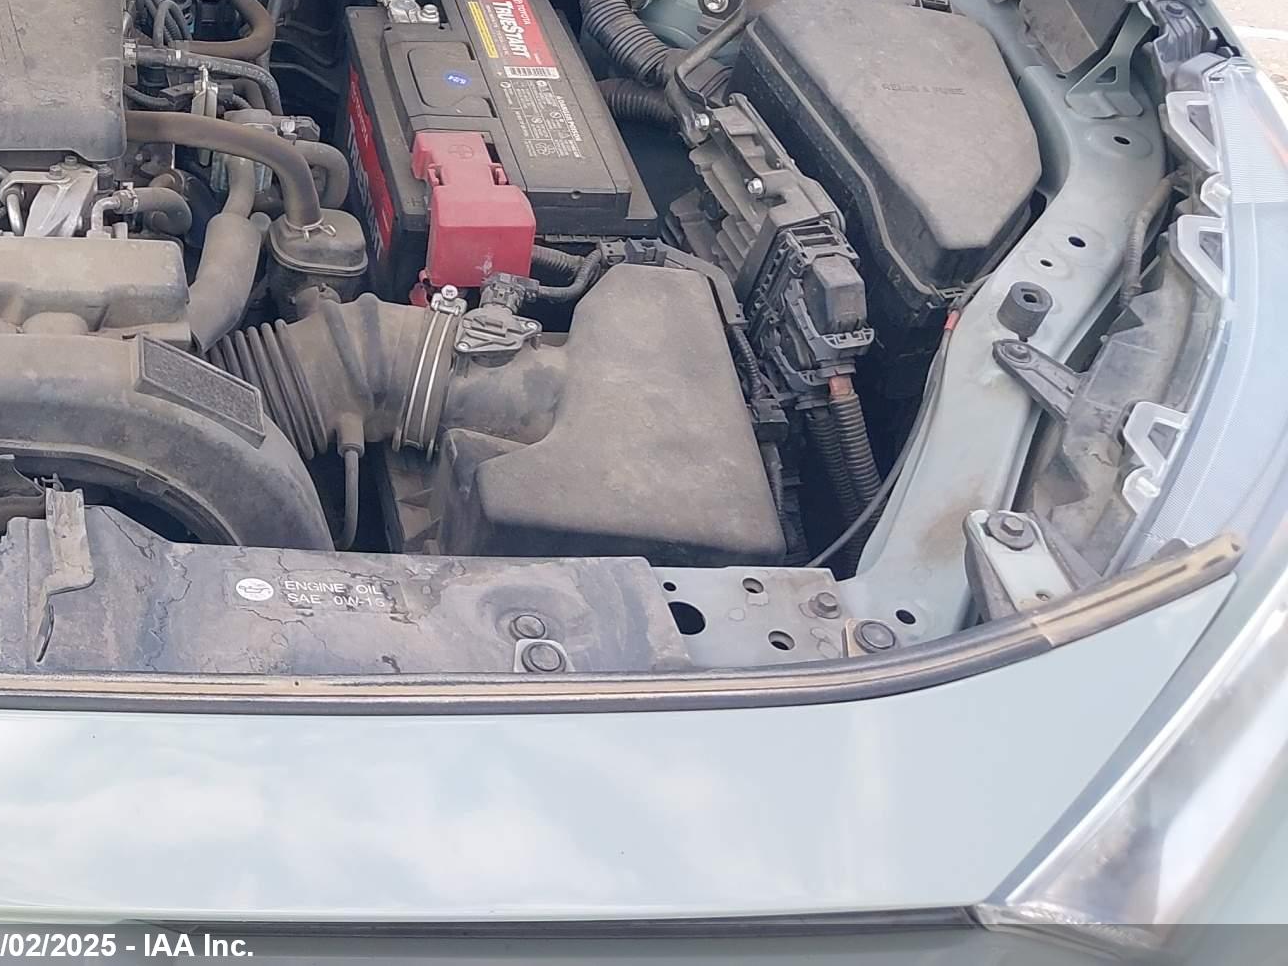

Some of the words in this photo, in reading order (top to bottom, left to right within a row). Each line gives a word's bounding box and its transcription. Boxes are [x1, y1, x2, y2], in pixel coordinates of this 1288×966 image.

[284, 580, 345, 594] ENGINE
[355, 584, 384, 595] OIL
[287, 593, 321, 605] SAE
